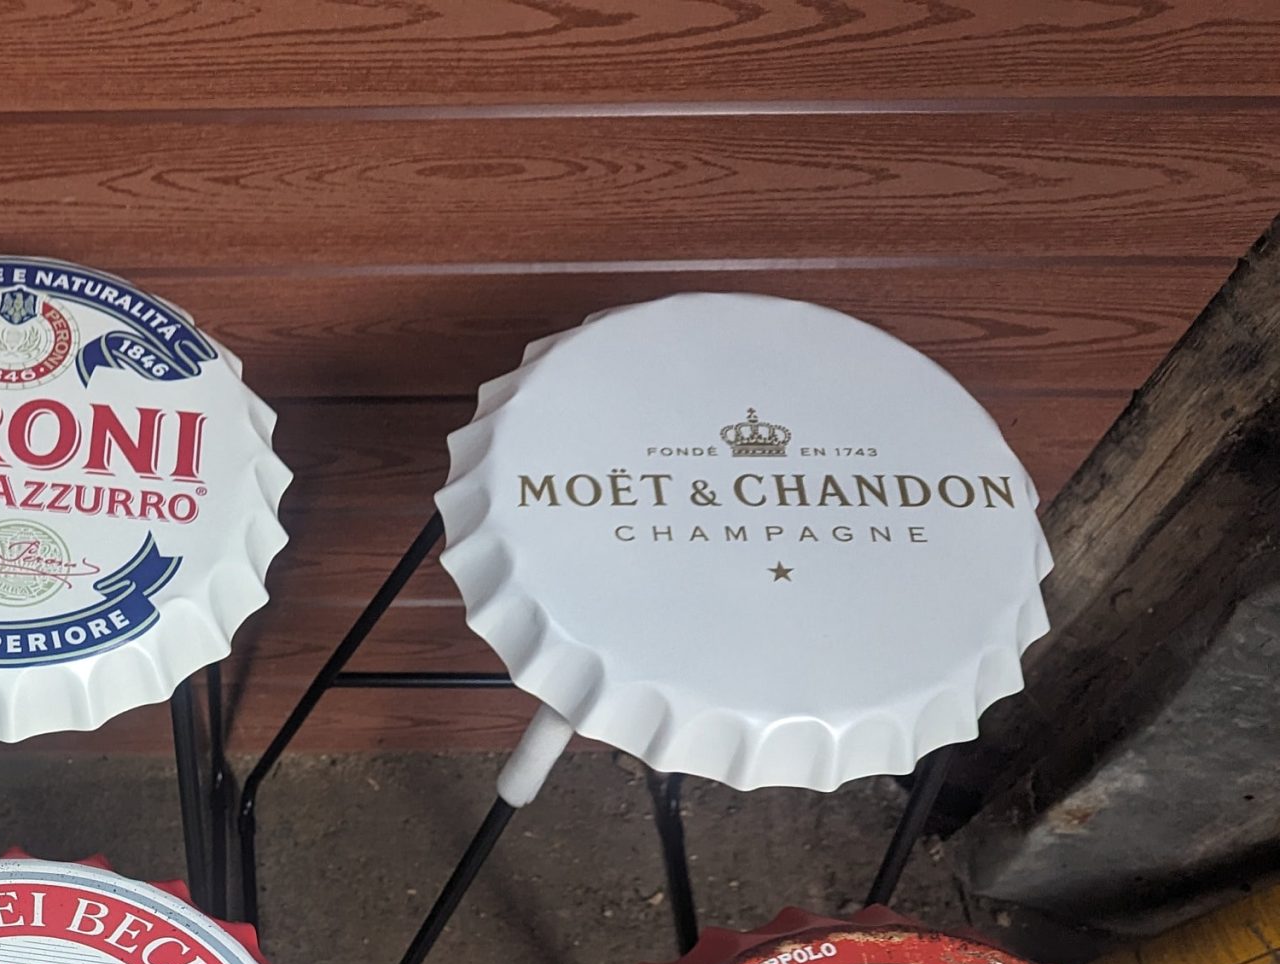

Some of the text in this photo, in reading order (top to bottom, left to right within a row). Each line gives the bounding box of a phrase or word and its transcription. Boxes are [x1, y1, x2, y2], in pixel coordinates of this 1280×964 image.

[13, 268, 26, 282] E
[44, 311, 69, 370] PERONI
[119, 339, 169, 377] 1846
[800, 447, 827, 457] EN
[834, 446, 878, 457] 1743
[517, 468, 1016, 509] MOËT & CHANDON
[614, 524, 929, 544] CHAMPAGNE
